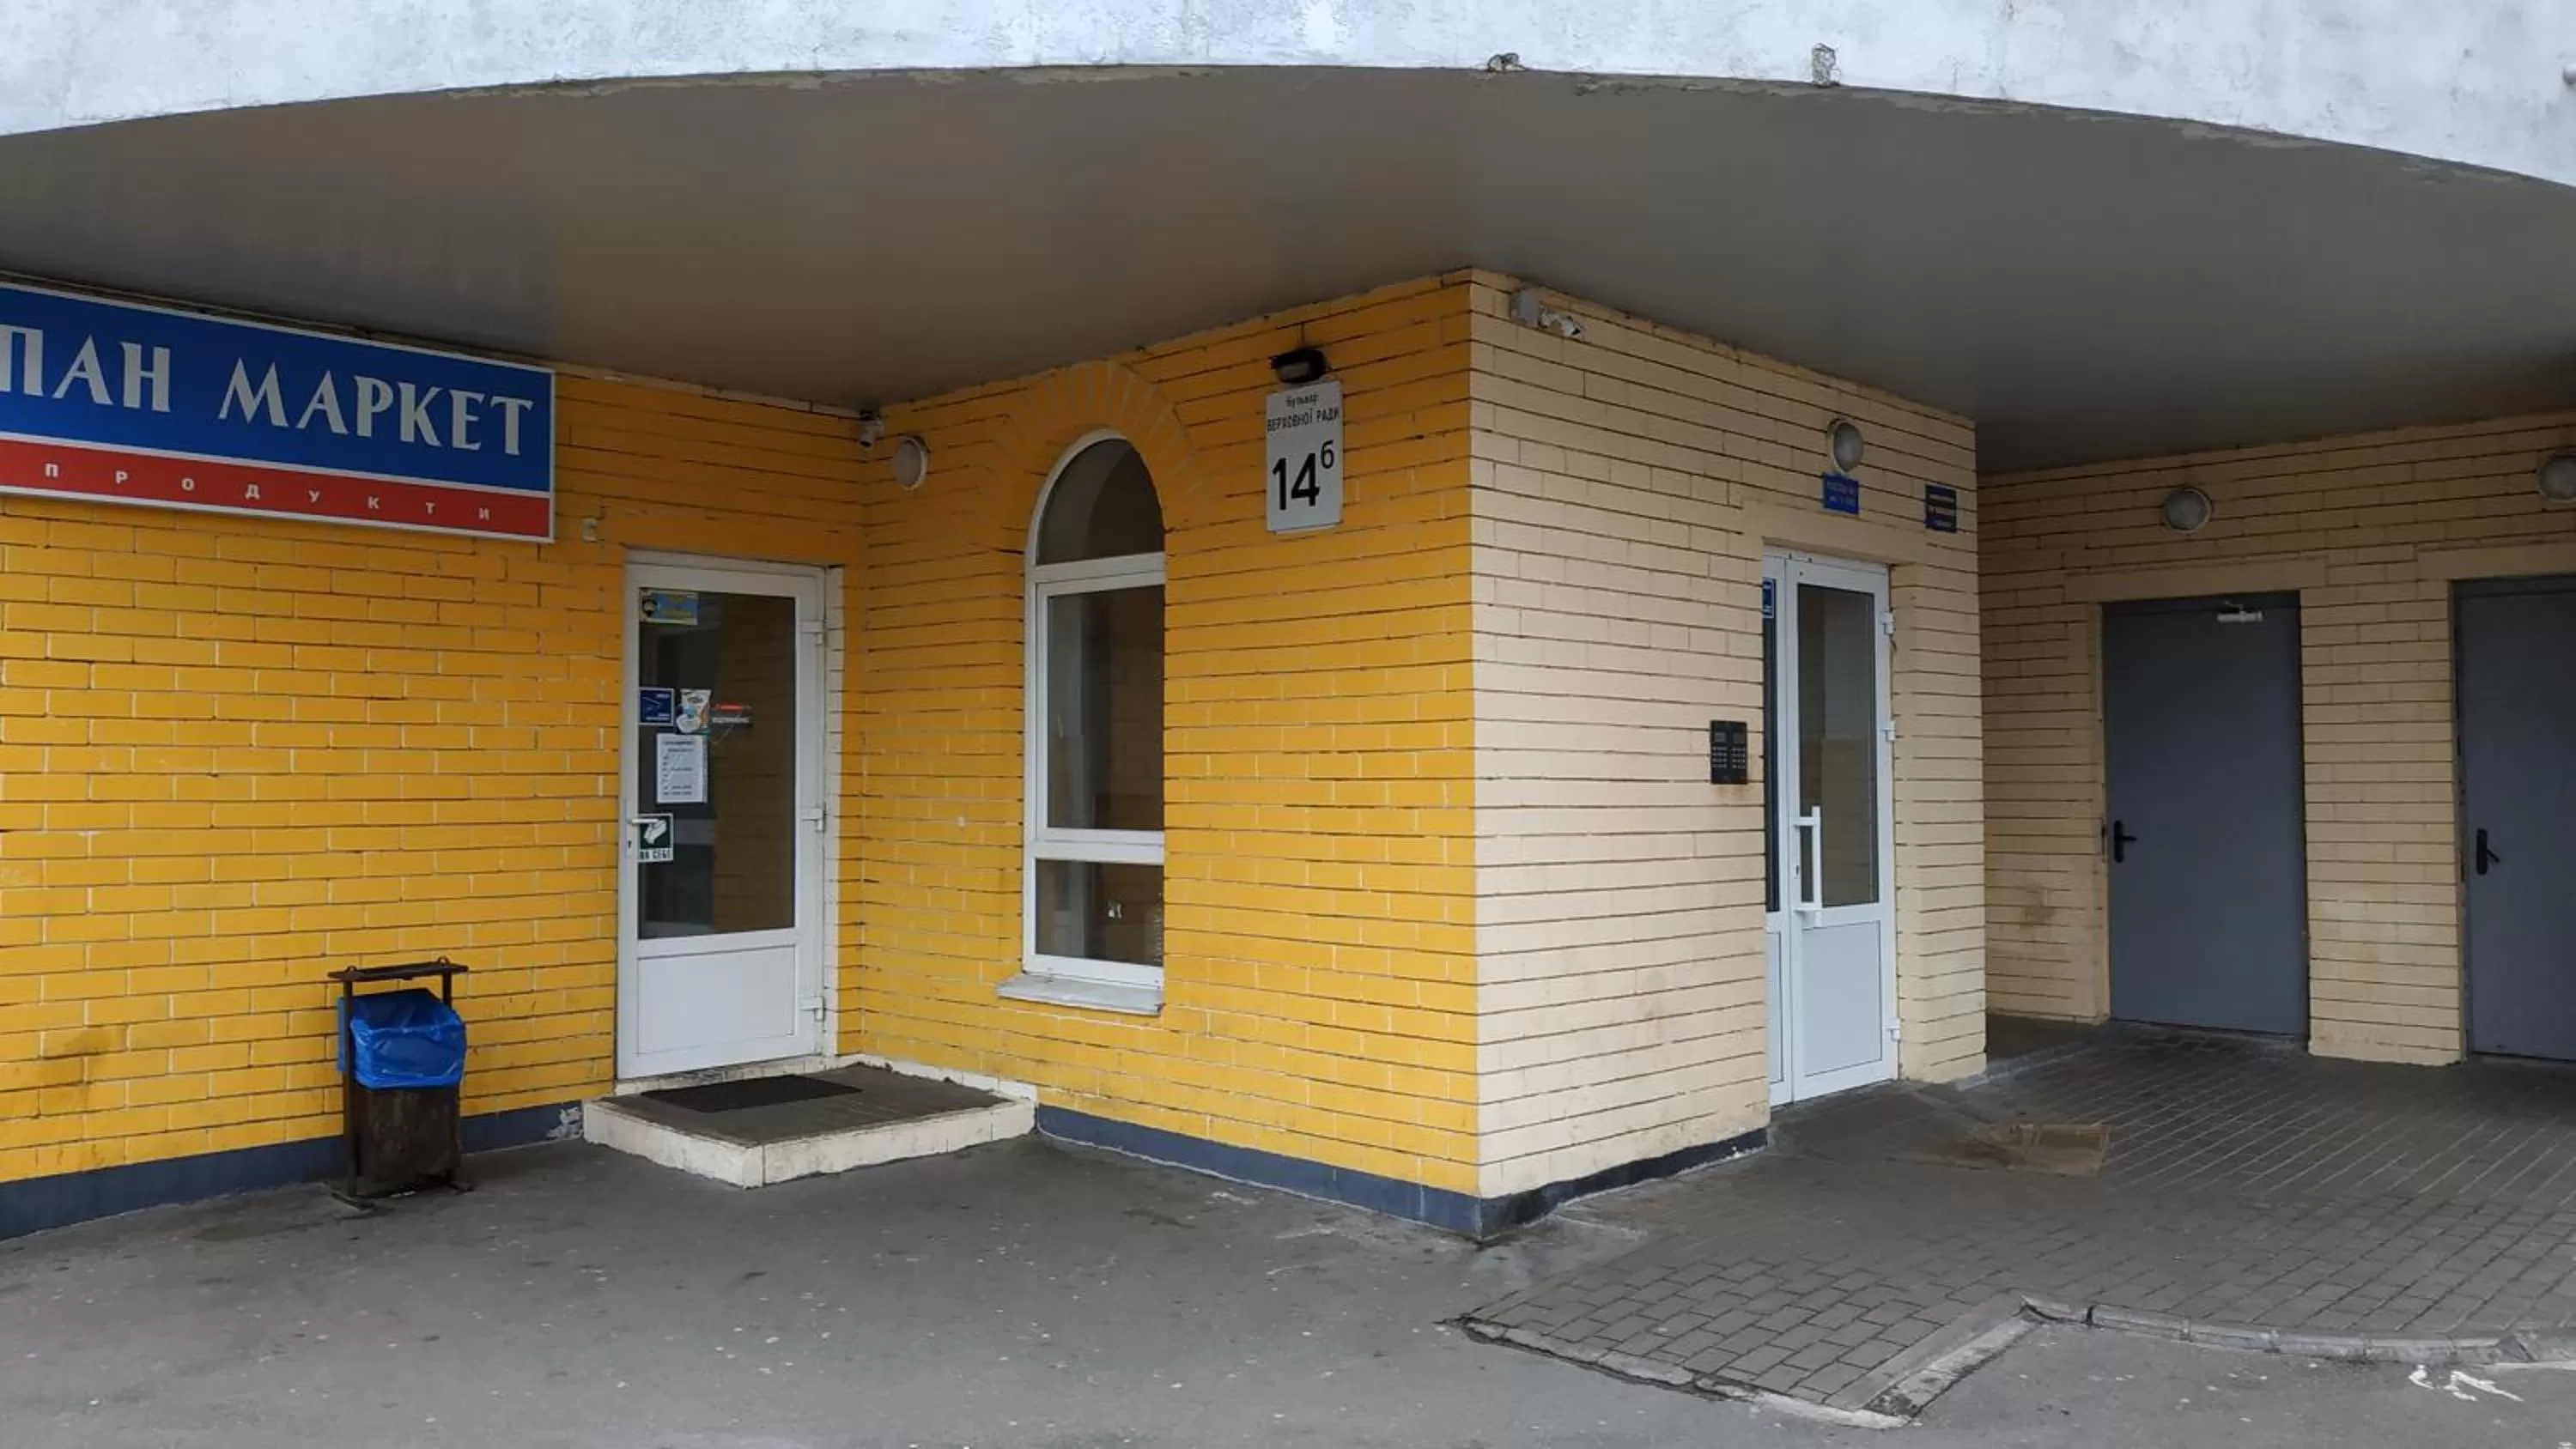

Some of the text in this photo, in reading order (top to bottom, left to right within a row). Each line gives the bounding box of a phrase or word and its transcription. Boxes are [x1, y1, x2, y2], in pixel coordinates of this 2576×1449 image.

[0, 324, 535, 456] ПАН МАРКЕТ
[1316, 407, 1340, 422] РАДИ
[45, 463, 490, 520] ПРОДУКТИ
